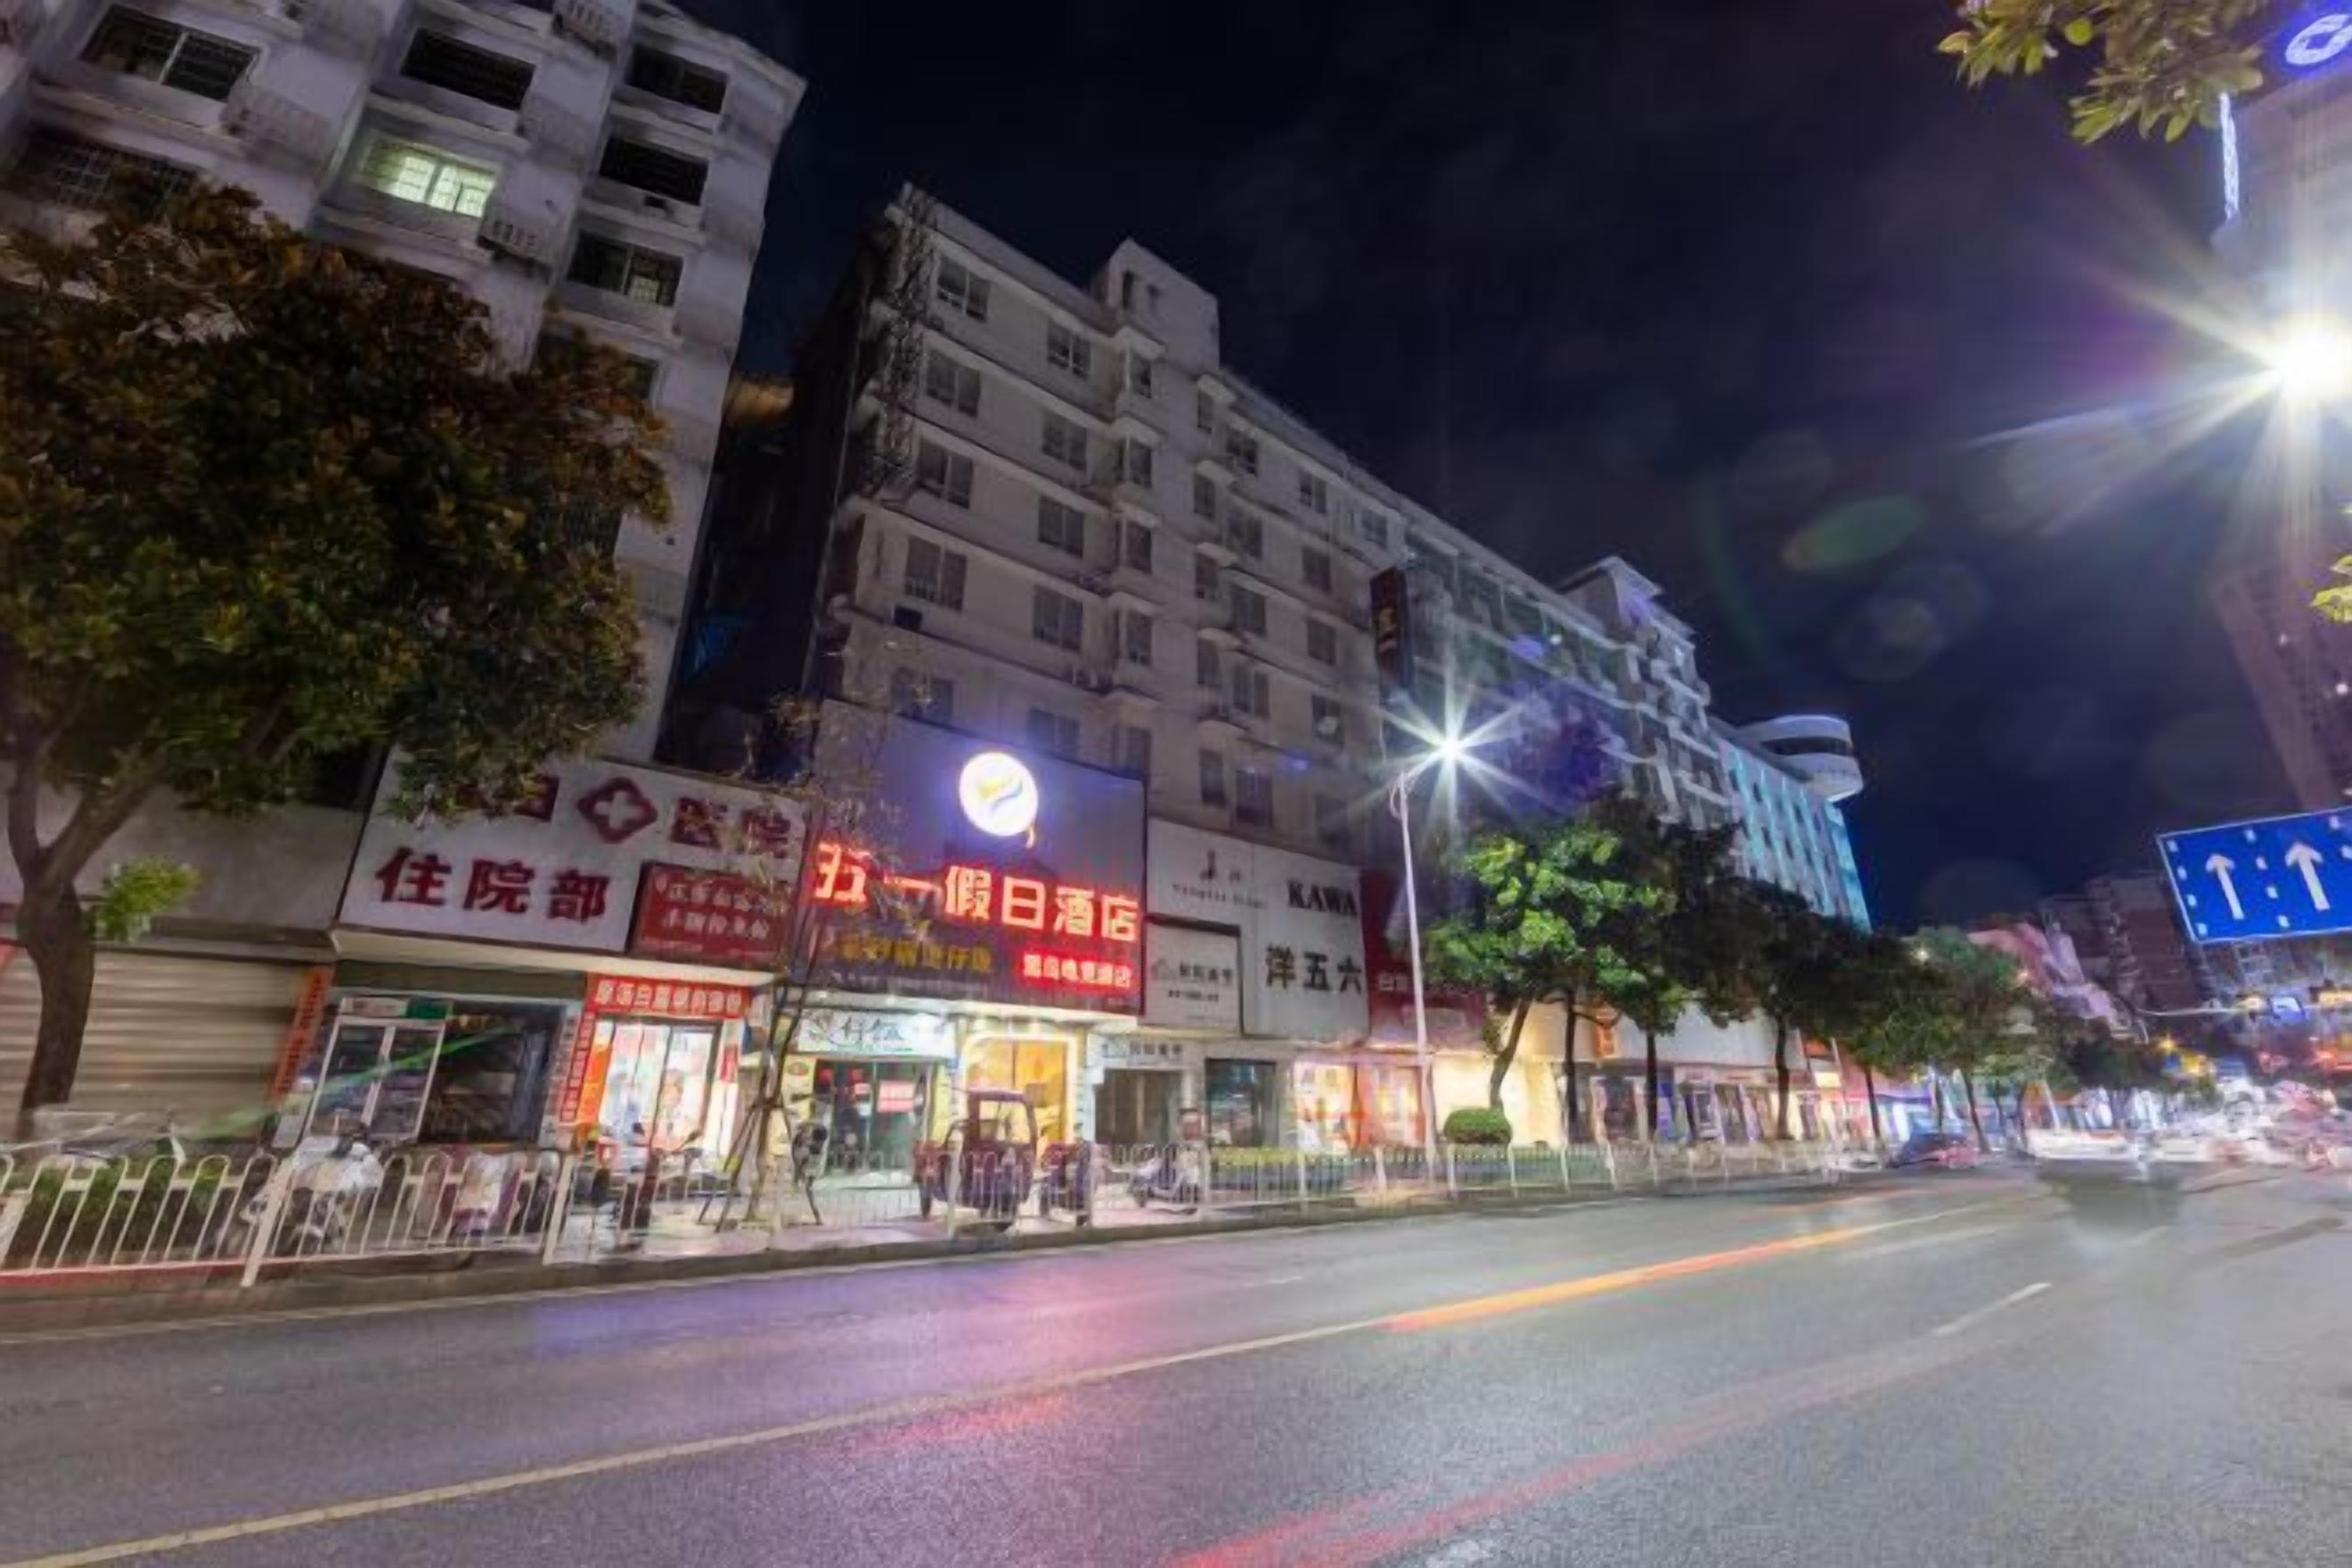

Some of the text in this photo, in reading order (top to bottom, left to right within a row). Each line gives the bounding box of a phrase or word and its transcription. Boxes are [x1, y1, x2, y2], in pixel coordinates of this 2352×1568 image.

[375, 846, 610, 923] 住院部
[814, 841, 1139, 942] 五一假日酒店
[1288, 879, 1359, 916] KAWA
[1265, 943, 1363, 996] 洋五六
